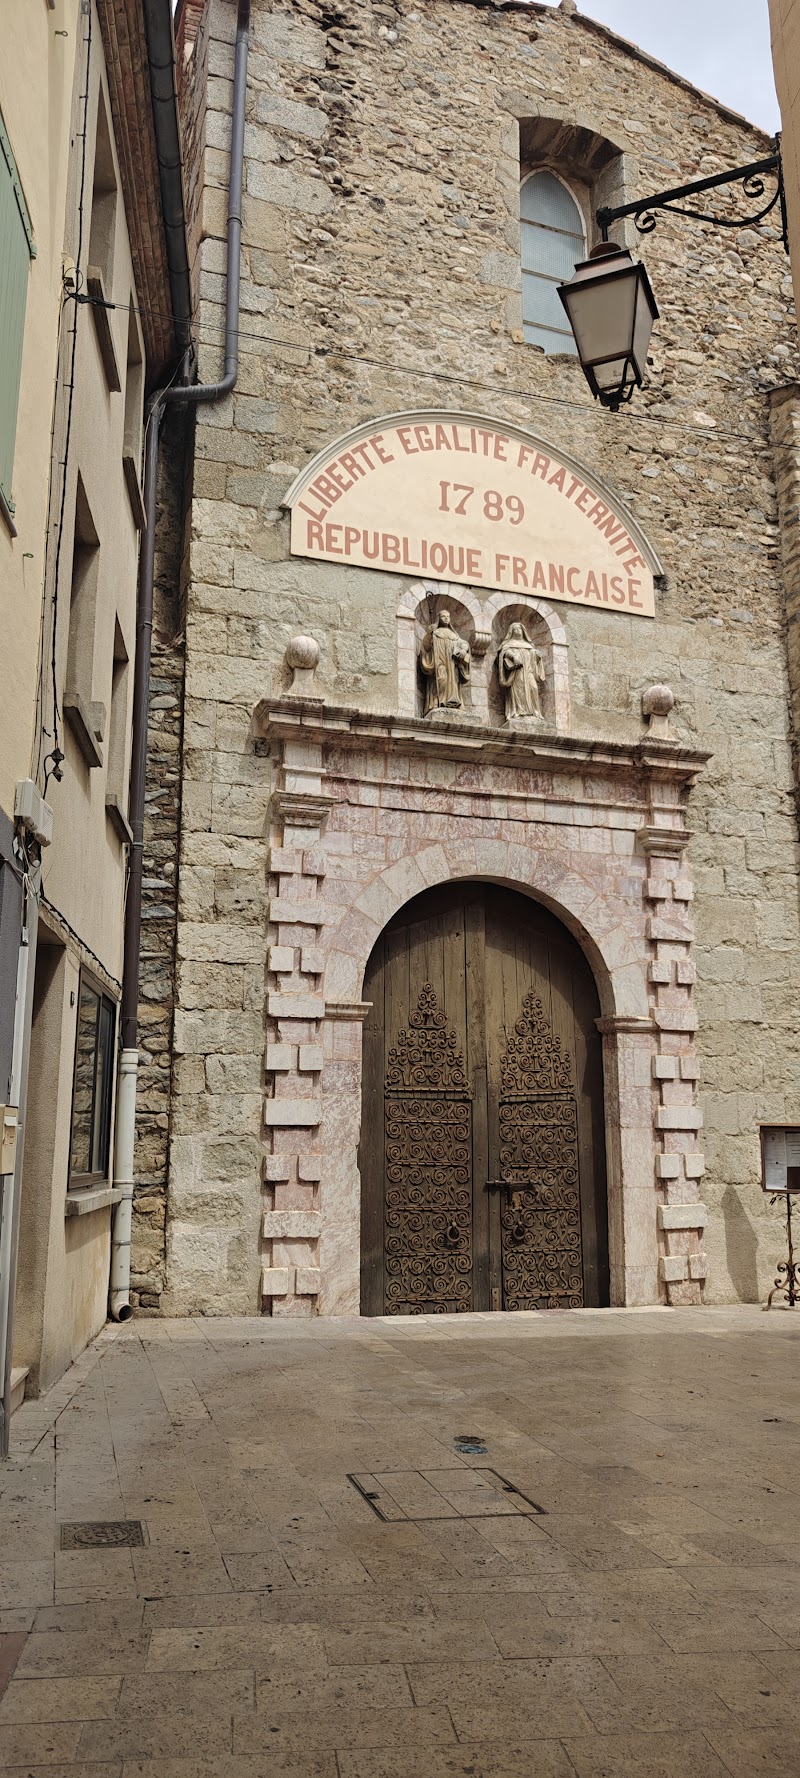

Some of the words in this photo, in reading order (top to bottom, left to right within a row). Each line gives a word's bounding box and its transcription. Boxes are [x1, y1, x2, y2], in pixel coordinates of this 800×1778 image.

[298, 434, 395, 523] LIBERTÉ
[307, 519, 483, 579] REPUBLIQUE
[495, 553, 644, 609] FRANÇAISE
